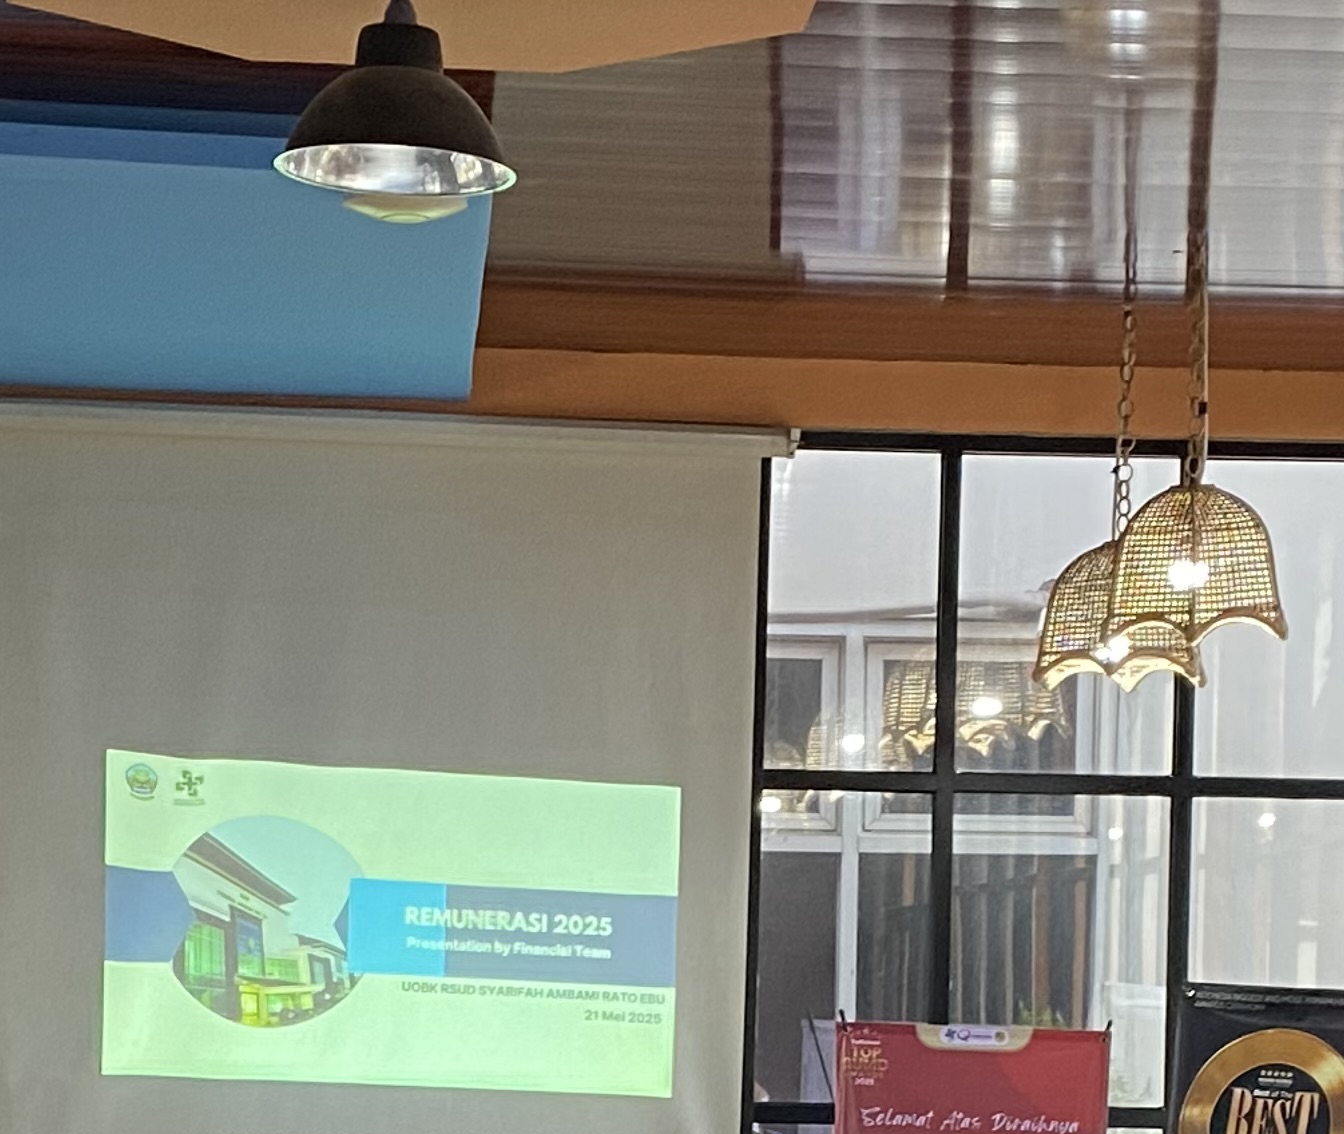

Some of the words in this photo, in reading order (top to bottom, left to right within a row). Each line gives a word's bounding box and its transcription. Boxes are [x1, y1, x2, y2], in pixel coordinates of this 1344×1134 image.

[405, 905, 548, 933] REMUNERASI
[553, 914, 613, 936] 2025
[407, 936, 492, 953] Presentation
[493, 940, 511, 957] by
[513, 942, 572, 957] Financial
[574, 944, 612, 960] Team
[402, 981, 439, 995] UOBK
[440, 982, 476, 996] RSUD
[478, 984, 544, 999] SYARIFAH
[546, 988, 600, 1002] AMBAMI
[602, 990, 637, 1004] RATO
[640, 993, 666, 1006] EBU
[584, 1009, 598, 1022] 21
[602, 1010, 626, 1023] Mei
[628, 1011, 662, 1024] 2025
[860, 1107, 935, 1129] Selamat
[939, 1110, 983, 1132] Atas
